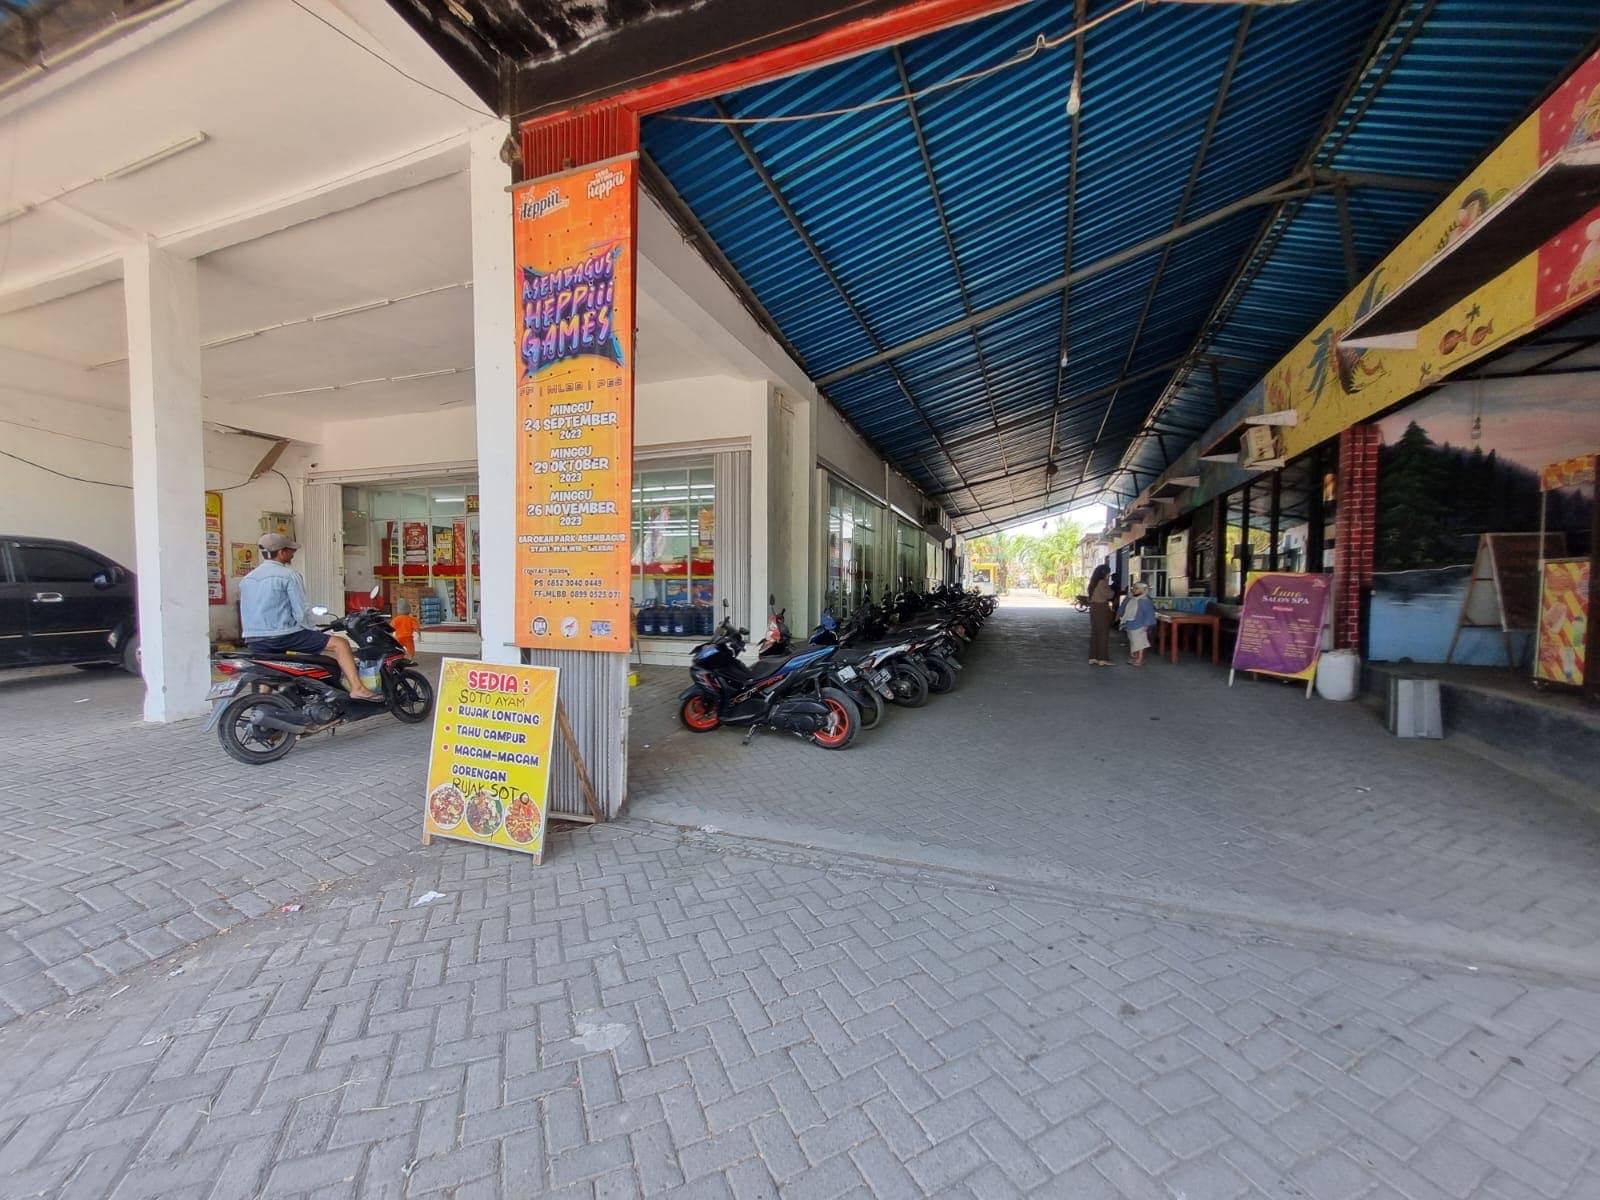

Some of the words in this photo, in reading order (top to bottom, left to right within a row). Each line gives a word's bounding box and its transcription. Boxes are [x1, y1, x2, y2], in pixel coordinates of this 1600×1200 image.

[522, 251, 614, 301] ASEMBAGUS
[521, 307, 611, 366] GAMES
[550, 401, 593, 416] MINGGU
[524, 418, 541, 431] 24
[543, 412, 618, 430] SEPTEMBER
[559, 429, 582, 440] 2023
[550, 446, 593, 460] MINGGU
[534, 461, 549, 475] 29
[550, 458, 609, 473] OKTOBER
[559, 472, 582, 483] 2023
[550, 489, 593, 502] MINGGU
[526, 503, 542, 516] 26
[544, 501, 616, 516] NOVEMBER
[559, 516, 582, 526] 2023
[554, 534, 576, 543] PARK
[1291, 597, 1310, 605] SPA
[468, 671, 519, 694] SEDIA
[458, 689, 492, 706] SOTO
[496, 696, 526, 708] AYAM
[458, 704, 490, 719] RUJAK
[492, 709, 540, 725] LONTONG
[456, 724, 482, 738] TAHU
[484, 728, 527, 744] CAMPUR
[454, 744, 540, 767] MACAM-MACAM
[452, 764, 507, 783] GORENGAN
[452, 778, 486, 800] RUJAK
[490, 785, 530, 805] SOTO
